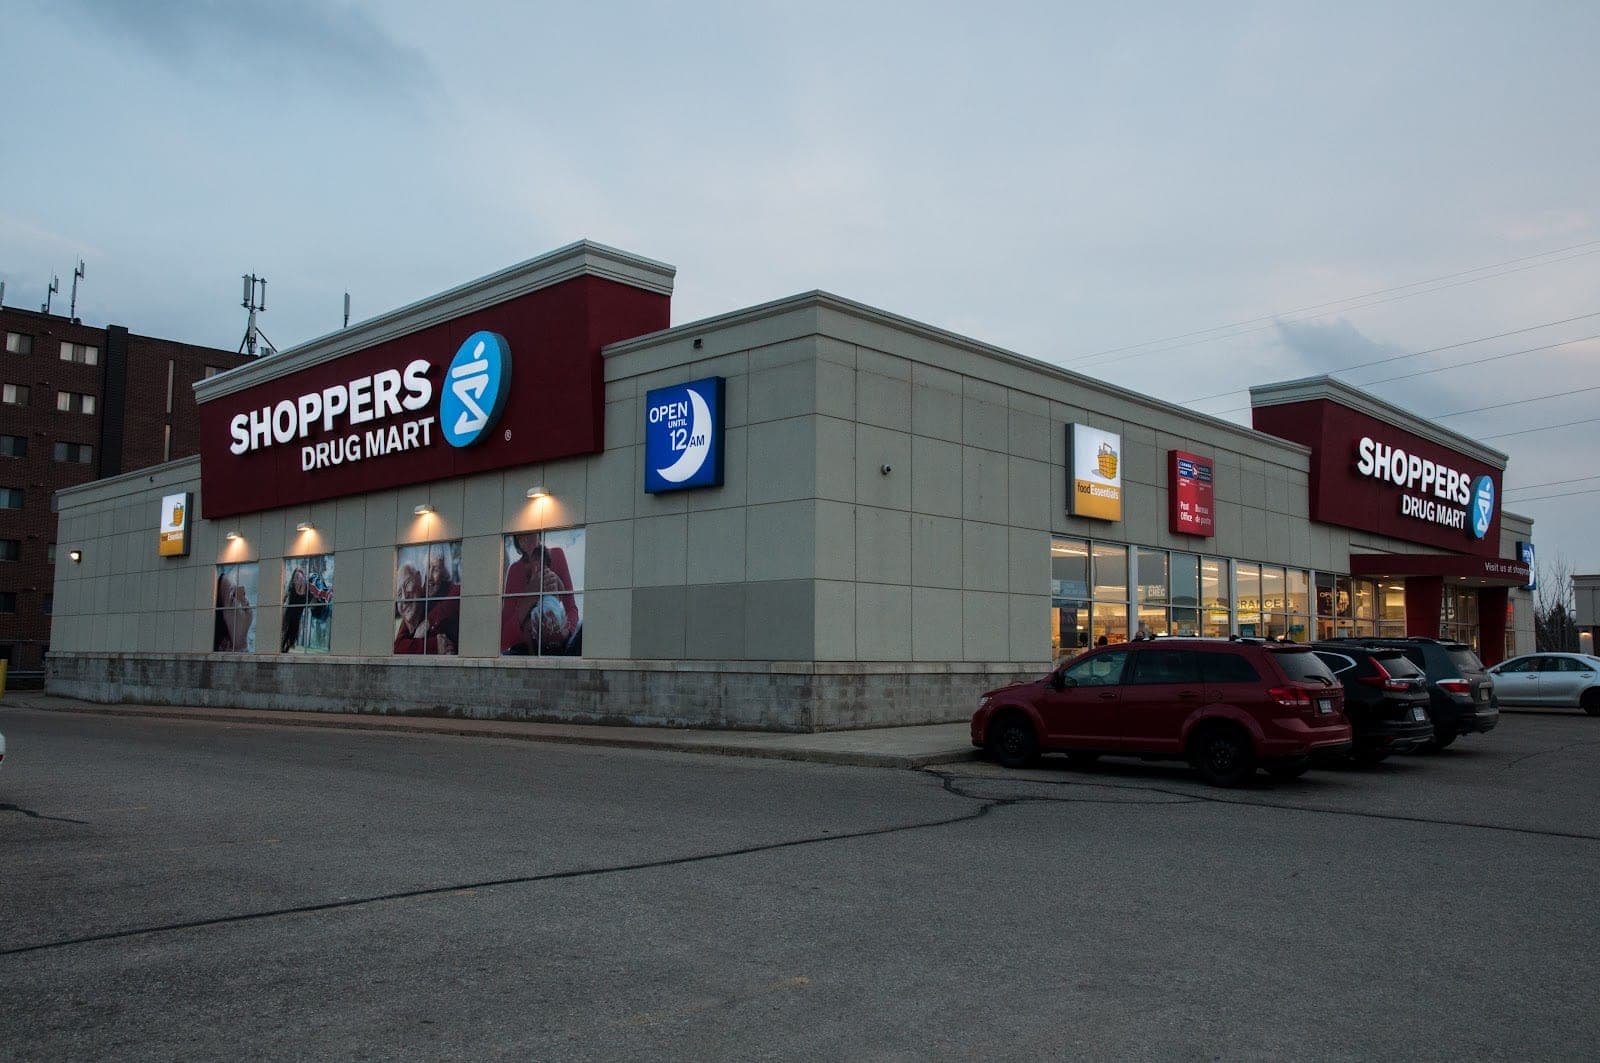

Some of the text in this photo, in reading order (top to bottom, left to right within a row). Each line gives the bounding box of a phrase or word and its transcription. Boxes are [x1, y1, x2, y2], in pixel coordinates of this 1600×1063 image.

[230, 360, 433, 454] SHOPPERS
[649, 401, 688, 423] OPEN
[668, 419, 688, 429] UNTIL
[301, 417, 435, 470] DRUG MART
[669, 428, 705, 451] 12 AM
[1357, 436, 1470, 506] SHOPPERS
[1401, 494, 1467, 530] DRUG MART
[1484, 561, 1499, 573] Visit
